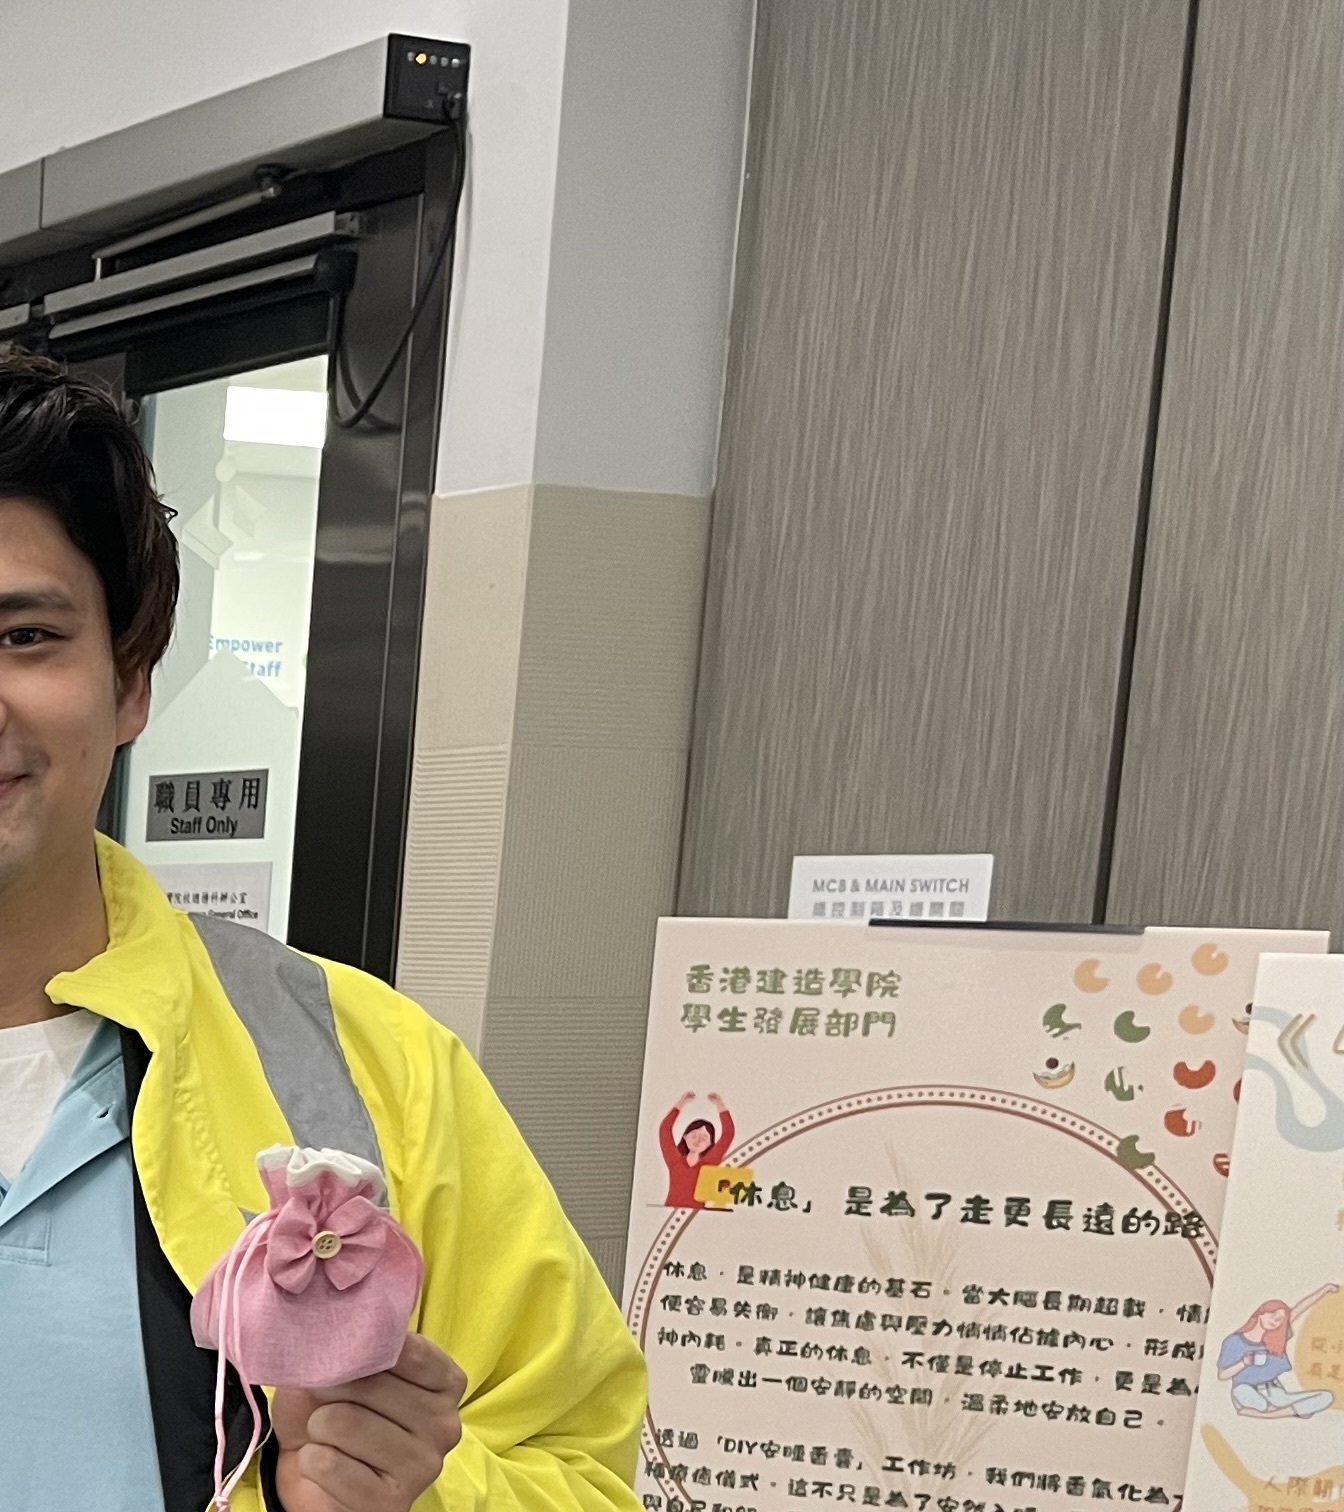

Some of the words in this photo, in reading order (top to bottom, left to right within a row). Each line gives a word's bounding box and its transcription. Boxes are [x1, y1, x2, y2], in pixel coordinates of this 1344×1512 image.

[244, 660, 281, 677] taff
[152, 777, 261, 814] 職員專用
[170, 816, 202, 835] Staff
[206, 815, 238, 838] Only
[812, 878, 847, 893] MCB
[865, 878, 905, 894] MAIN
[910, 878, 970, 893] SWITCH
[686, 963, 903, 998] 香港建造學院
[680, 1002, 897, 1038] 學生發展部門
